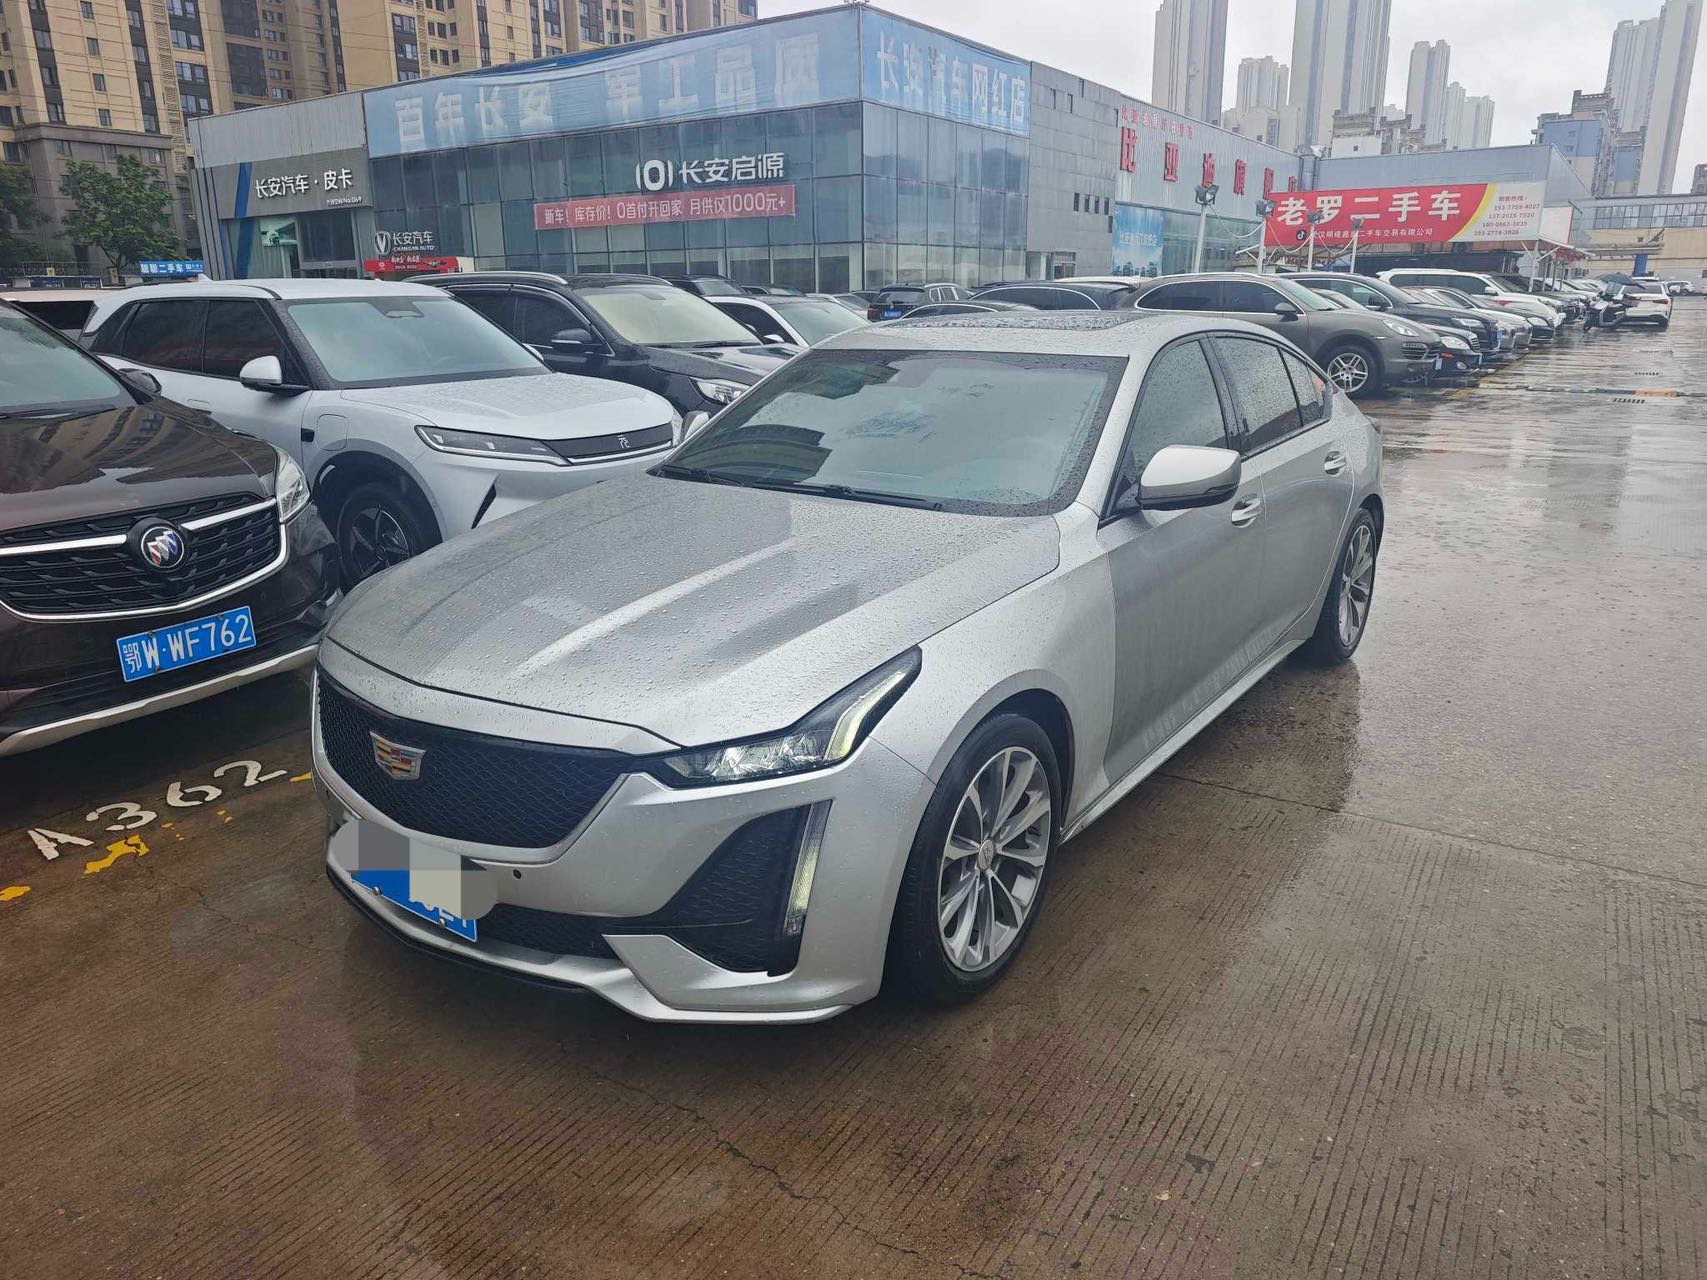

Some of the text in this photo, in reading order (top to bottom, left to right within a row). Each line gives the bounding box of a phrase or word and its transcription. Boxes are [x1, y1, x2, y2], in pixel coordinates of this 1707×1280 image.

[255, 168, 354, 198] 长安汽车·皮卡
[678, 152, 785, 184] 长安启源
[689, 192, 786, 215] 月供仅1000元+
[1277, 190, 1462, 226] 老罗二手车
[392, 230, 433, 245] 长安汽车
[27, 760, 288, 860] A362
